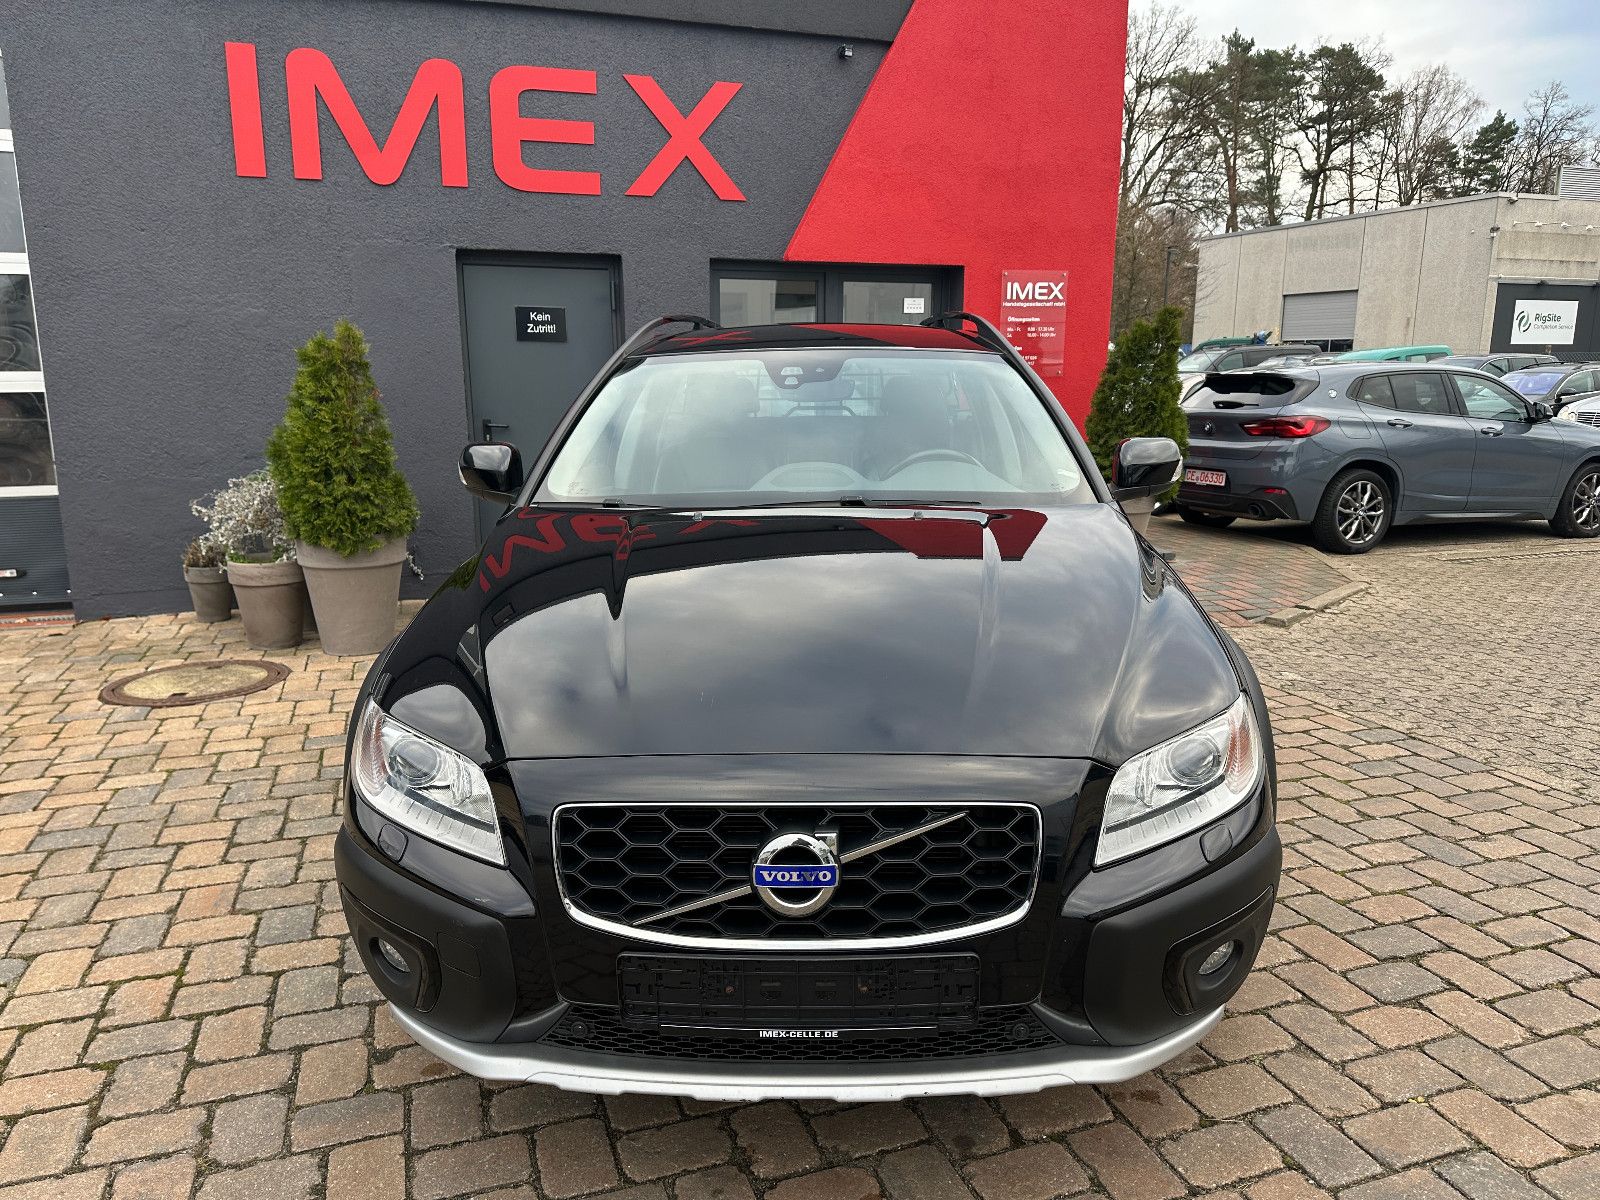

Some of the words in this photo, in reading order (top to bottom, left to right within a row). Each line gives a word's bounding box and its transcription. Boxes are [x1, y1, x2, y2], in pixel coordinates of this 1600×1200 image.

[225, 42, 747, 201] IMEX
[1006, 281, 1065, 300] IMEX
[529, 311, 551, 321] Kein
[1534, 313, 1561, 324] RigSite
[527, 323, 557, 333] Zutritt!
[1186, 470, 1196, 481] CE
[1199, 471, 1224, 484] 06330
[760, 870, 832, 882] VOLVO
[759, 1030, 839, 1038] IMEX-CELLE.DE
